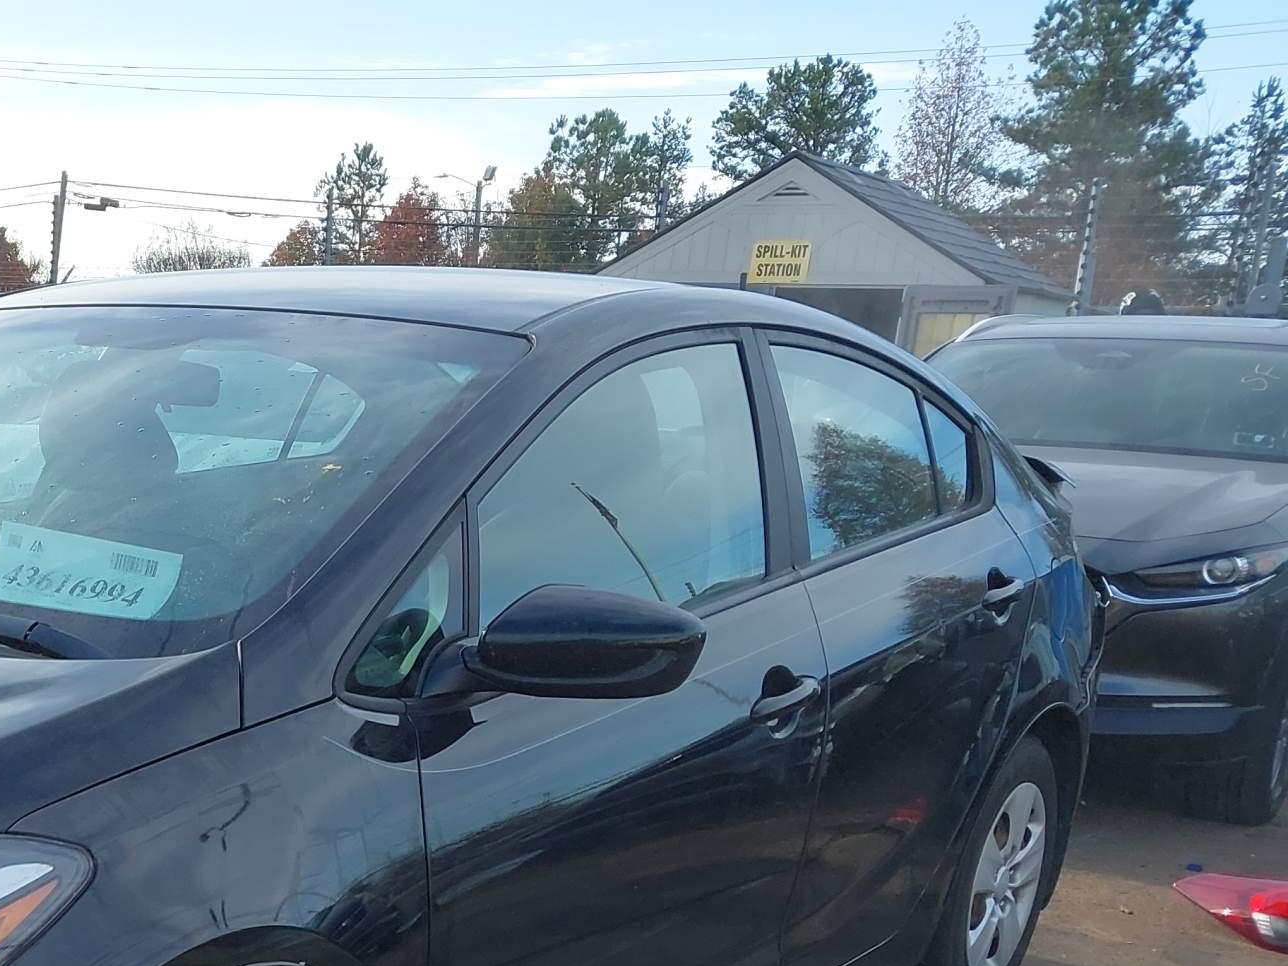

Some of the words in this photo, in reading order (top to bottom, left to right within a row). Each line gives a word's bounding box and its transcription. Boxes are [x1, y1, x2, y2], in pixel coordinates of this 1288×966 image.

[755, 244, 809, 258] SPILL-KIT
[756, 263, 802, 277] STATION
[2, 564, 145, 607] 43616994
